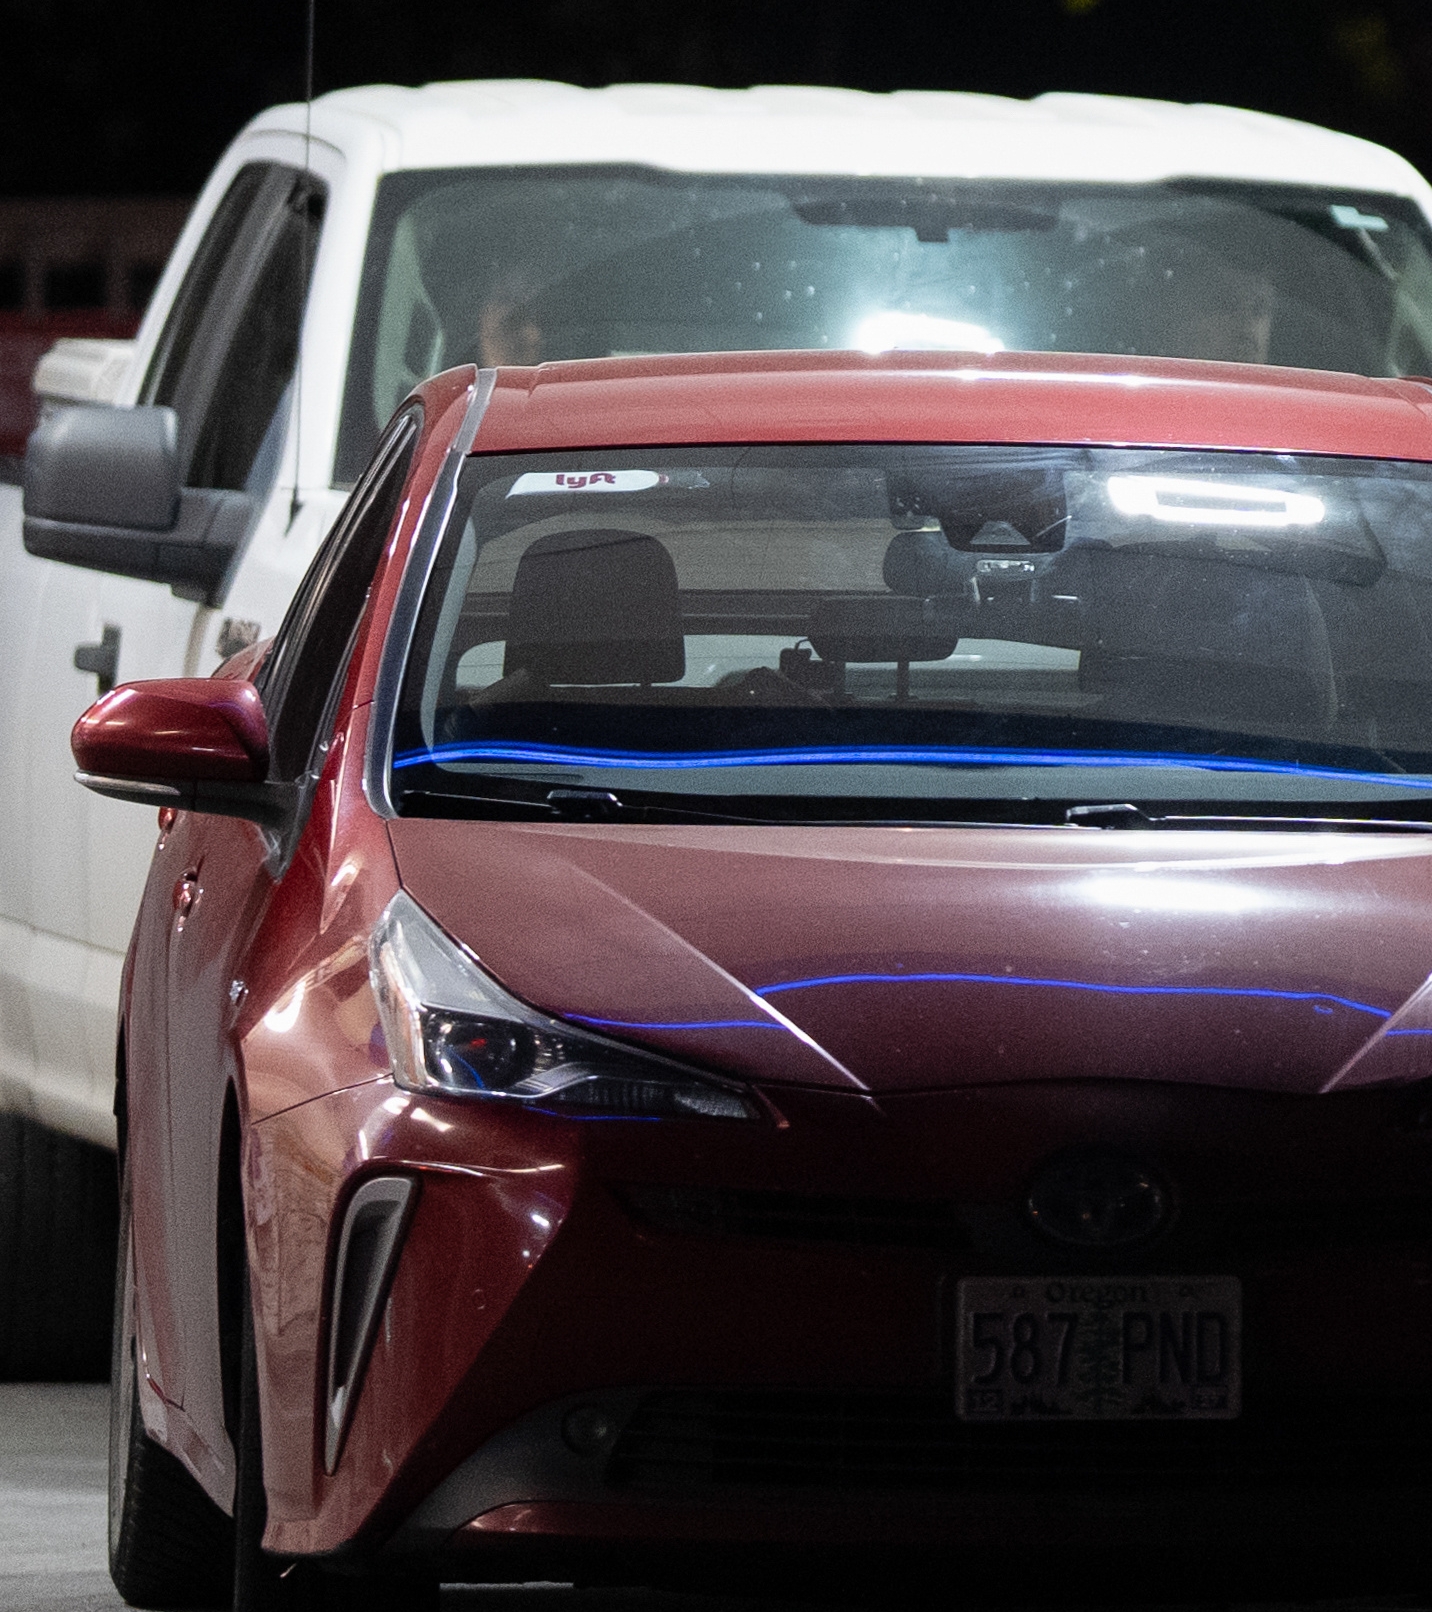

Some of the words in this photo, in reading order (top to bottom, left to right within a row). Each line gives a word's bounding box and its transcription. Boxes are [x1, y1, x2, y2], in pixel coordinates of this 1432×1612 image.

[555, 472, 616, 489] lyft
[1045, 1281, 1148, 1309] Oregon
[970, 1311, 1079, 1386] 587
[1121, 1311, 1229, 1385] PND
